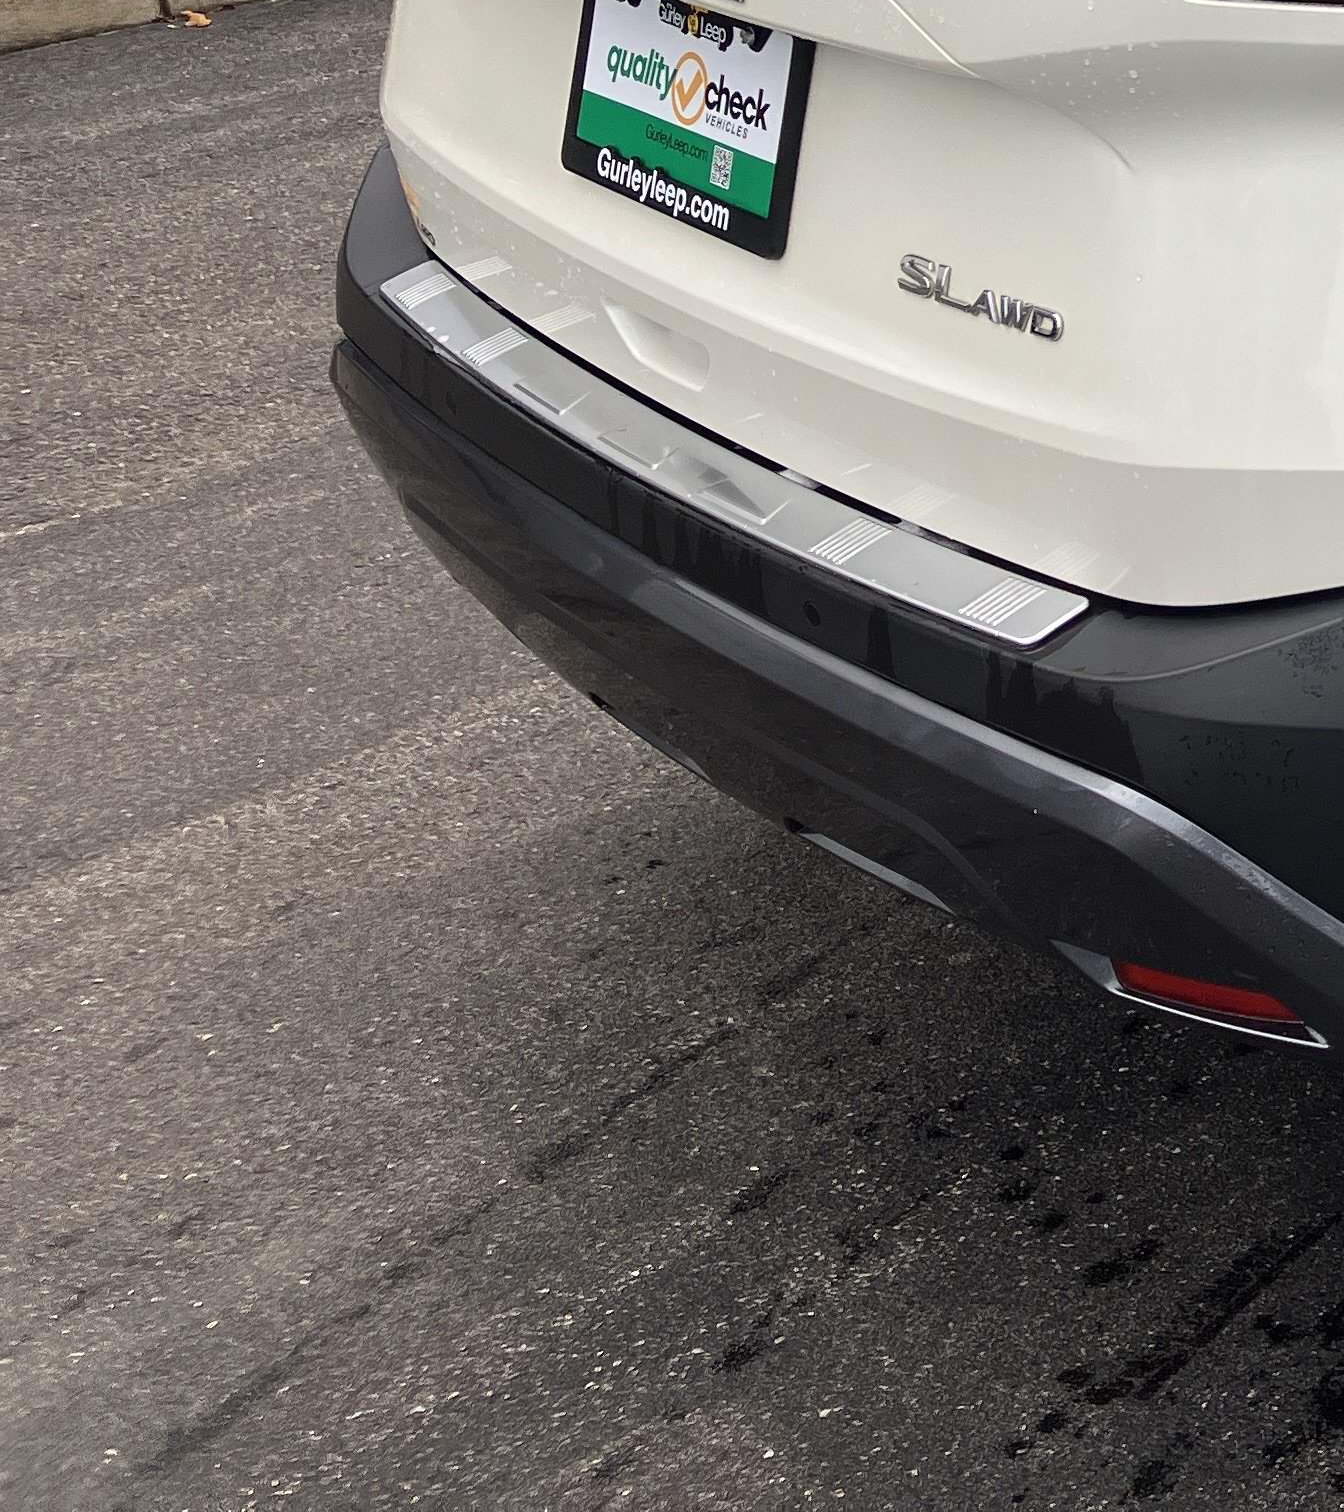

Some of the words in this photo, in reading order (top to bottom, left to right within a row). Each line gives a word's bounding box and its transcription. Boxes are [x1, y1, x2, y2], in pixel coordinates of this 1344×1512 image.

[700, 15, 727, 48] Leep
[607, 45, 677, 100] quality
[705, 75, 770, 131] check
[705, 112, 749, 139] VEHICLES
[597, 147, 730, 232] Gurleyleep.com
